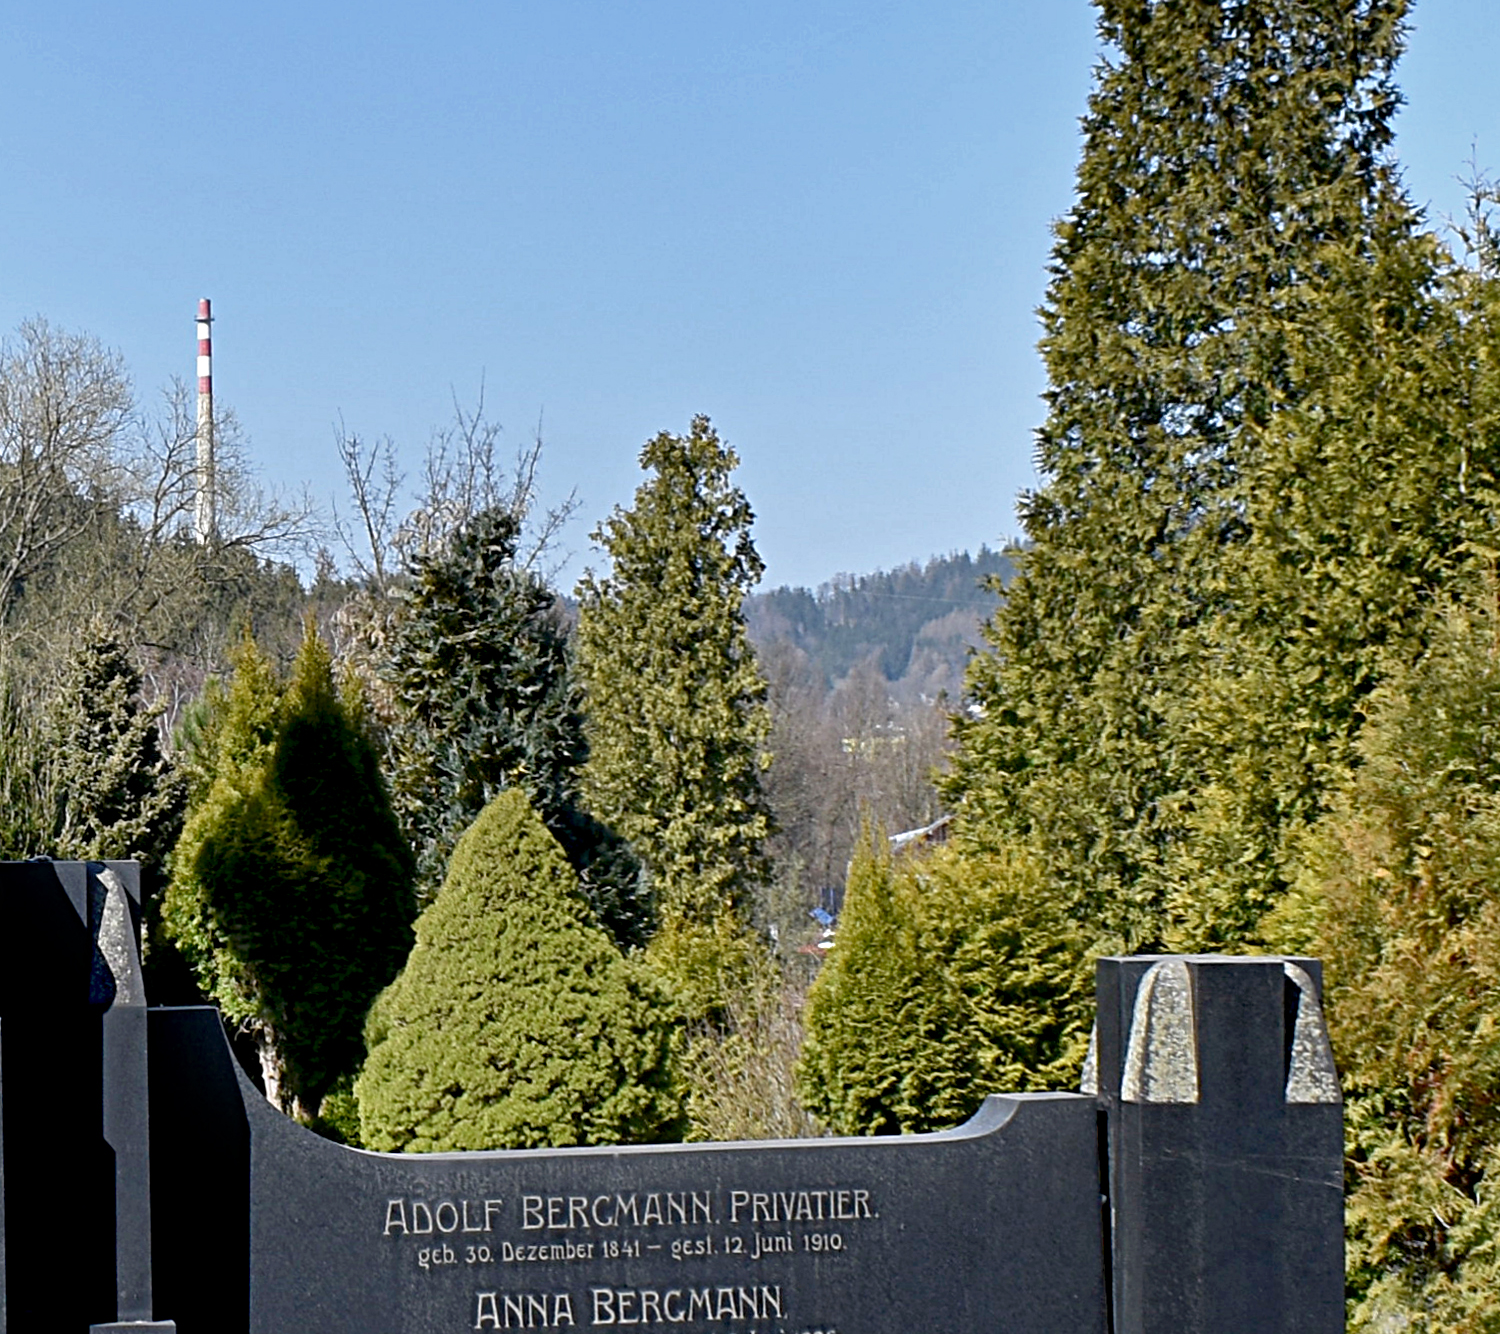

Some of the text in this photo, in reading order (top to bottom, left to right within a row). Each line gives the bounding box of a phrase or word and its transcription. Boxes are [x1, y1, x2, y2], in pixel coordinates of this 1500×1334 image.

[382, 1197, 503, 1236] ADOLF
[417, 1242, 458, 1270] geb.
[502, 1240, 594, 1263] Dezember
[602, 1237, 640, 1259] 1841
[750, 1230, 793, 1260] Juni
[803, 1232, 848, 1252] 1910.
[474, 1291, 575, 1330] ANNA
